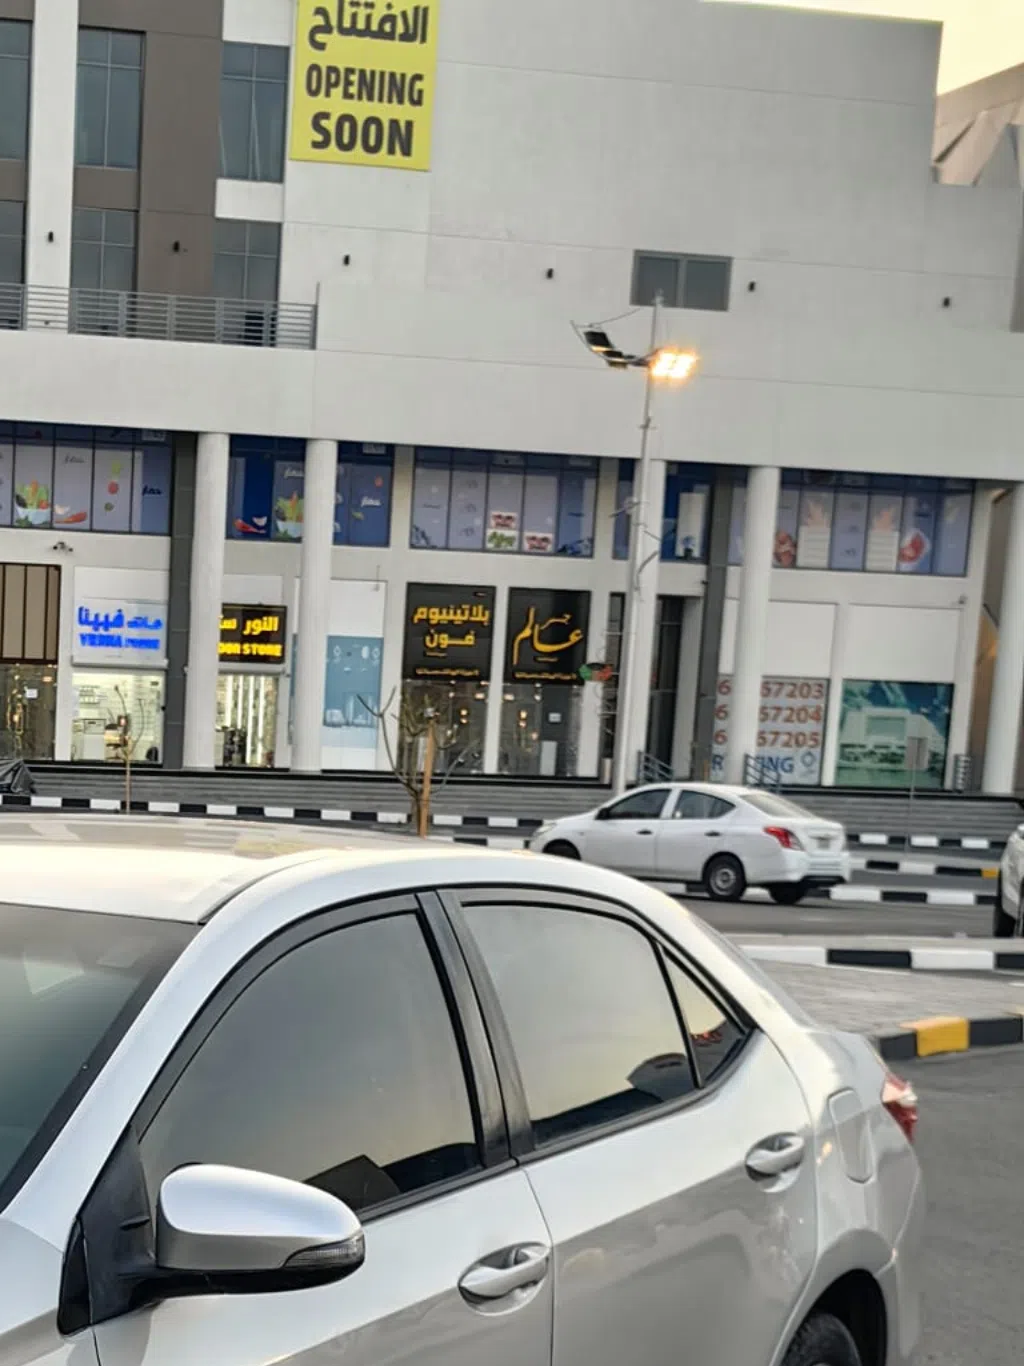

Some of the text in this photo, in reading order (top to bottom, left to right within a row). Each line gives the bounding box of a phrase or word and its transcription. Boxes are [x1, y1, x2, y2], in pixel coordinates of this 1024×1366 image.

[305, 63, 425, 107] OPENING
[311, 111, 414, 157] SOON
[242, 615, 279, 636] النور
[413, 604, 490, 626] بلاتينيوم
[425, 628, 476, 649] فون
[242, 643, 283, 657] STORE
